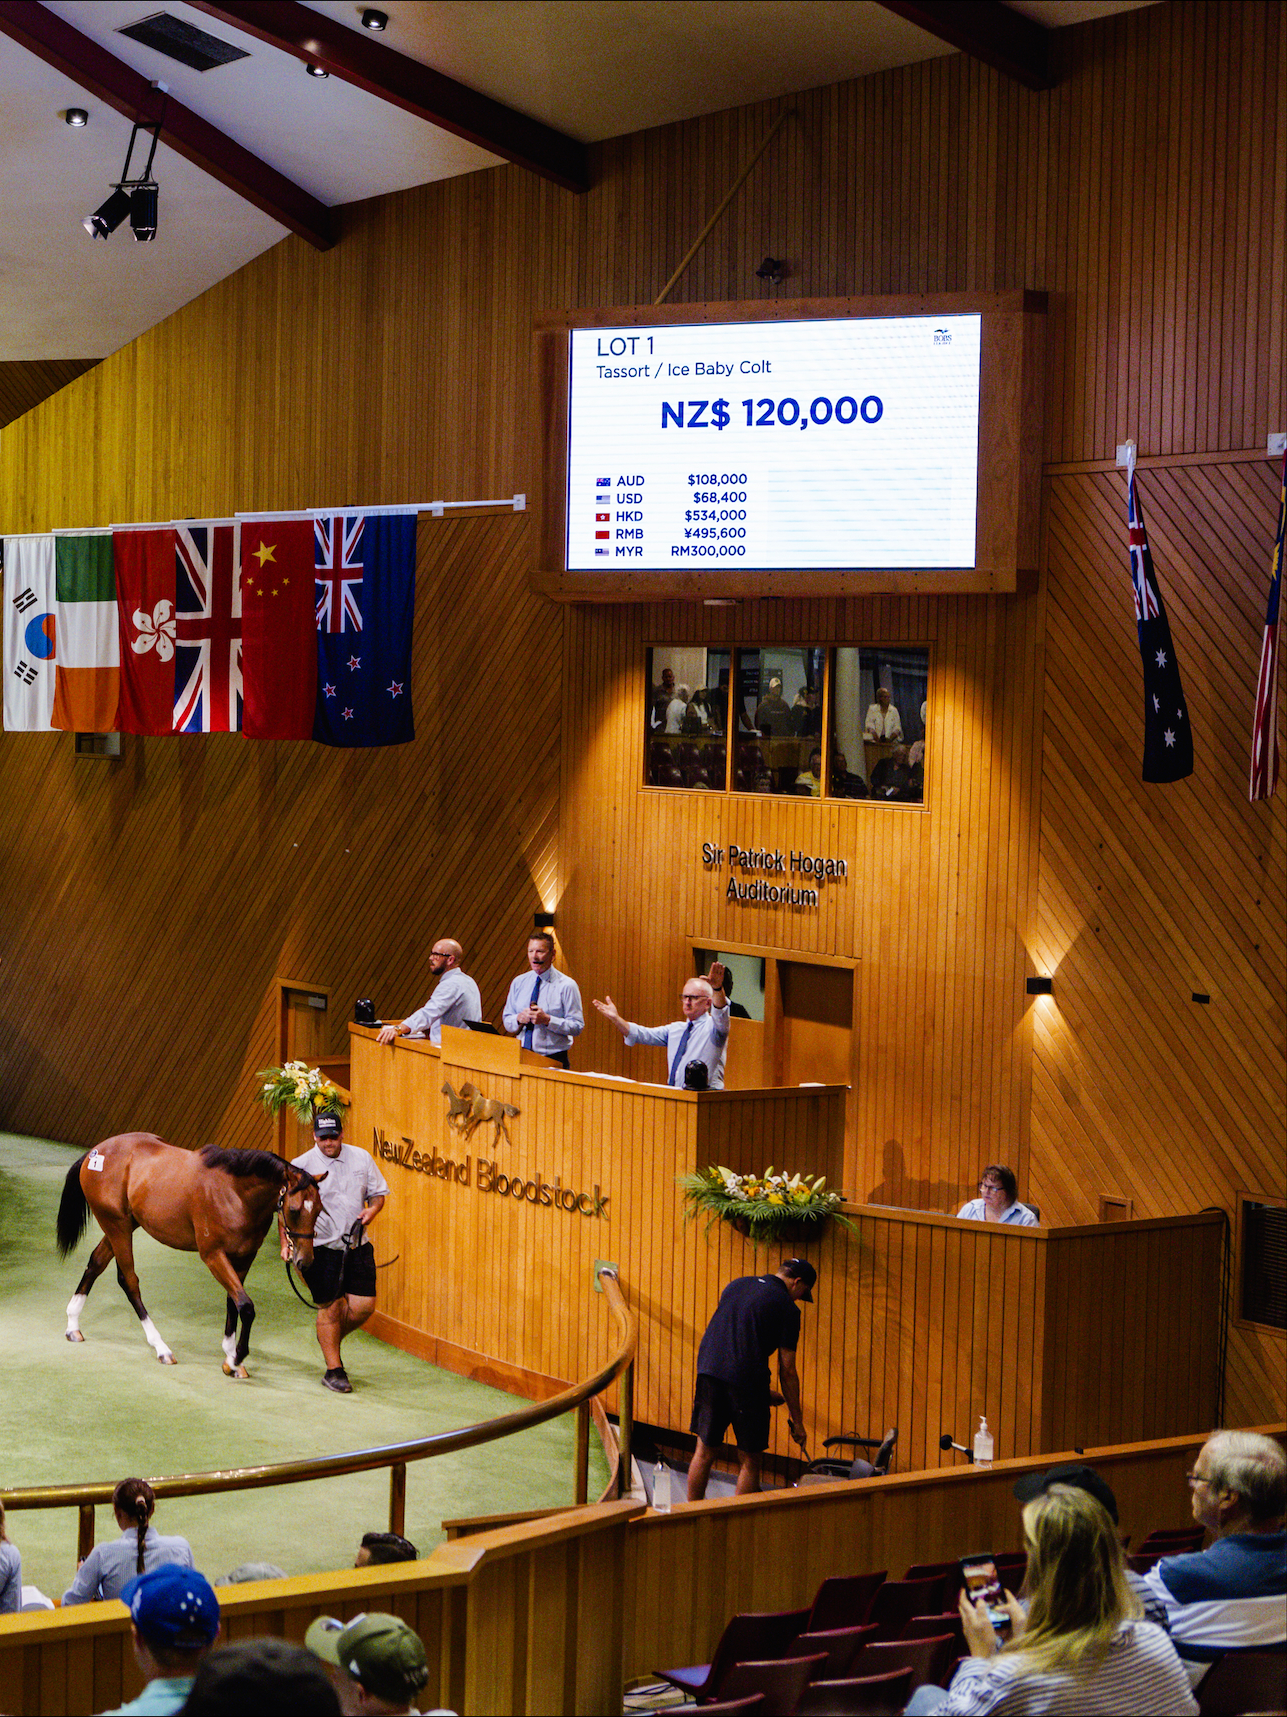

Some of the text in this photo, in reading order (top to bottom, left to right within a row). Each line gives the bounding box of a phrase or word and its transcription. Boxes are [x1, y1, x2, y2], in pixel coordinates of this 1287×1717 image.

[597, 336, 654, 357] LOT 1
[596, 360, 772, 379] Tassort / Ice Baby Colt
[661, 395, 884, 431] NZ$ 120,000
[616, 473, 748, 487] AUD $108,000
[616, 491, 748, 505] USD $68,400
[616, 509, 747, 523] HKD $534,000
[615, 527, 747, 541] RMB ¥495,600
[615, 545, 746, 558] MYR RM300,000
[702, 842, 848, 880] Sir Patrick Hogan
[726, 877, 818, 907] Auditorium
[477, 1155, 610, 1221] Bloodstock
